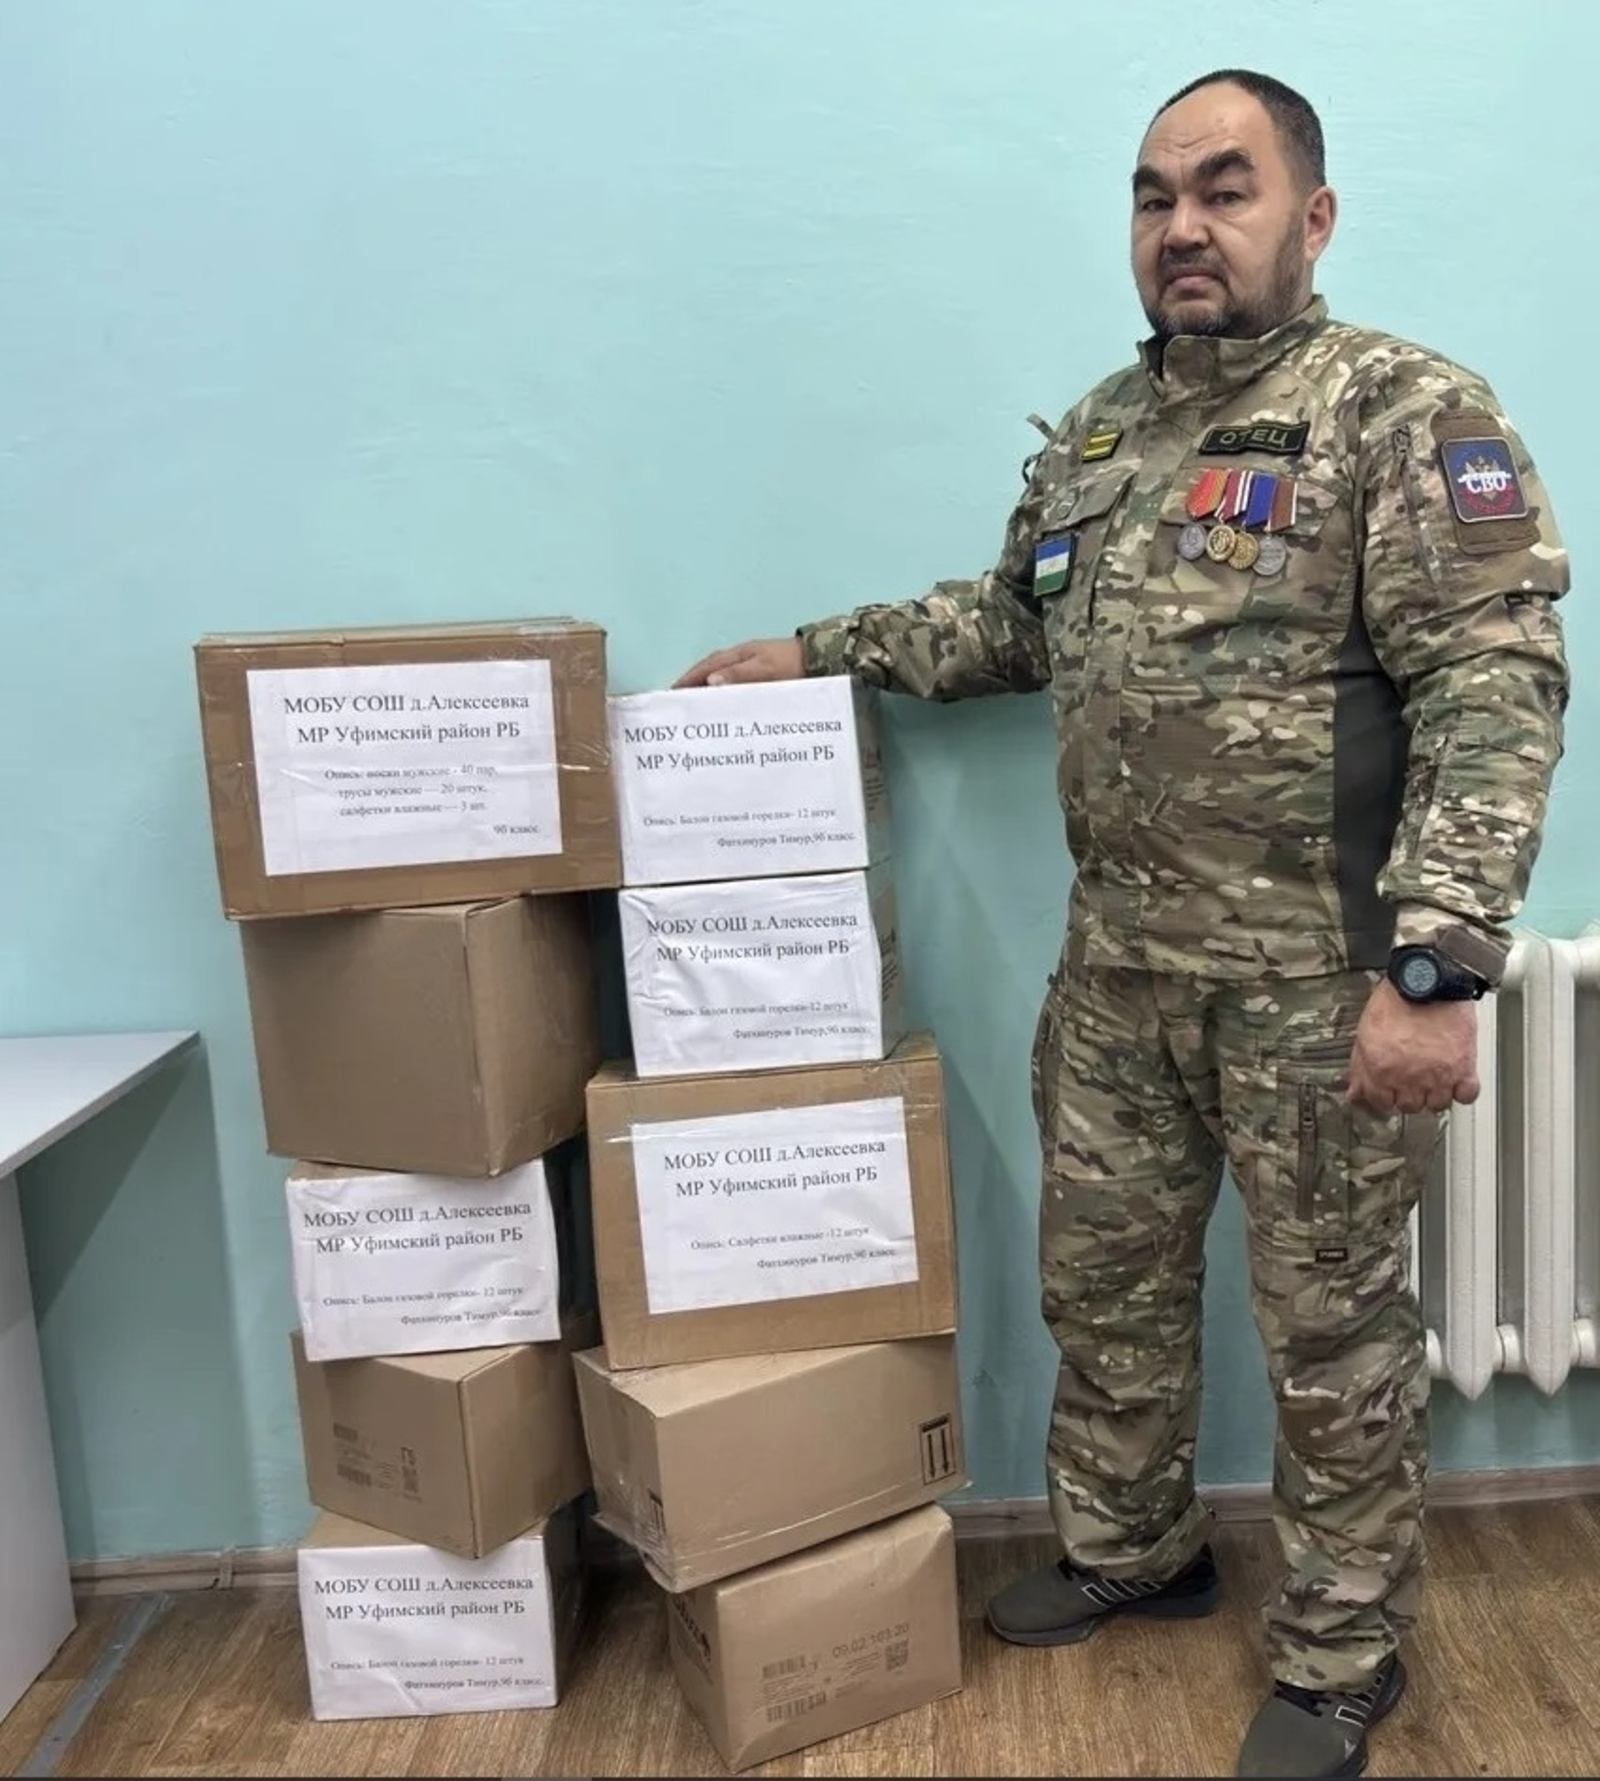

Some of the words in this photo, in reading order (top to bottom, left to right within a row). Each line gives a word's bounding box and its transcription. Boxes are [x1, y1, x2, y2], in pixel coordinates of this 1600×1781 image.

[1220, 429, 1287, 447] ОТЕЦ
[1466, 474, 1506, 494] СВО
[283, 695, 350, 715] МОБУ
[353, 693, 405, 712] СОШ
[409, 693, 530, 713] д.Алексеевка
[298, 726, 329, 744] МР
[335, 723, 433, 747] Уфимский
[438, 721, 491, 744] район
[496, 721, 520, 739] РБ
[624, 725, 677, 743] МОБУ
[683, 723, 729, 740] СОШ
[734, 719, 842, 739] д.Алексеевка
[636, 754, 664, 770] МР
[668, 749, 755, 772] Уфимский
[759, 746, 808, 767] район
[812, 745, 834, 761] РБ
[462, 764, 473, 775] 40
[338, 788, 372, 799] трусы
[374, 785, 422, 797] мужские
[440, 783, 454, 794] 20
[340, 804, 390, 818] салфетки
[394, 803, 442, 814] влажные
[461, 801, 467, 812] 3
[712, 812, 749, 823] газовой
[797, 808, 809, 819] 12
[647, 918, 697, 934] МОБУ
[702, 916, 747, 933] СОШ
[752, 913, 858, 932] д.Алексеевка
[657, 946, 682, 962] МР
[687, 943, 772, 964] Уфимский
[776, 941, 823, 960] район
[828, 939, 850, 954] РБ
[664, 1151, 719, 1171] МОБУ
[724, 1146, 772, 1166] СОШ
[776, 1140, 886, 1163] д.Алексеевка
[676, 1181, 704, 1198] МР
[709, 1173, 798, 1198] Уфимский
[802, 1170, 851, 1190] район
[855, 1165, 877, 1182] РБ
[303, 1210, 361, 1228] МОБУ
[366, 1208, 414, 1224] СОШ
[419, 1203, 532, 1223] д.Алексеевка
[316, 1238, 345, 1254] МР
[350, 1232, 441, 1254] Уфимский
[445, 1230, 495, 1250] район
[500, 1226, 524, 1243] РБ
[483, 1286, 495, 1297] 12
[314, 1579, 370, 1594] МОБУ
[374, 1578, 420, 1592] СОШ
[425, 1577, 534, 1593] д.Алексеевка
[325, 1605, 353, 1620] МР
[358, 1602, 446, 1622] Уфимский
[451, 1600, 499, 1618] район
[502, 1600, 525, 1614] РБ
[485, 1657, 497, 1666] 12
